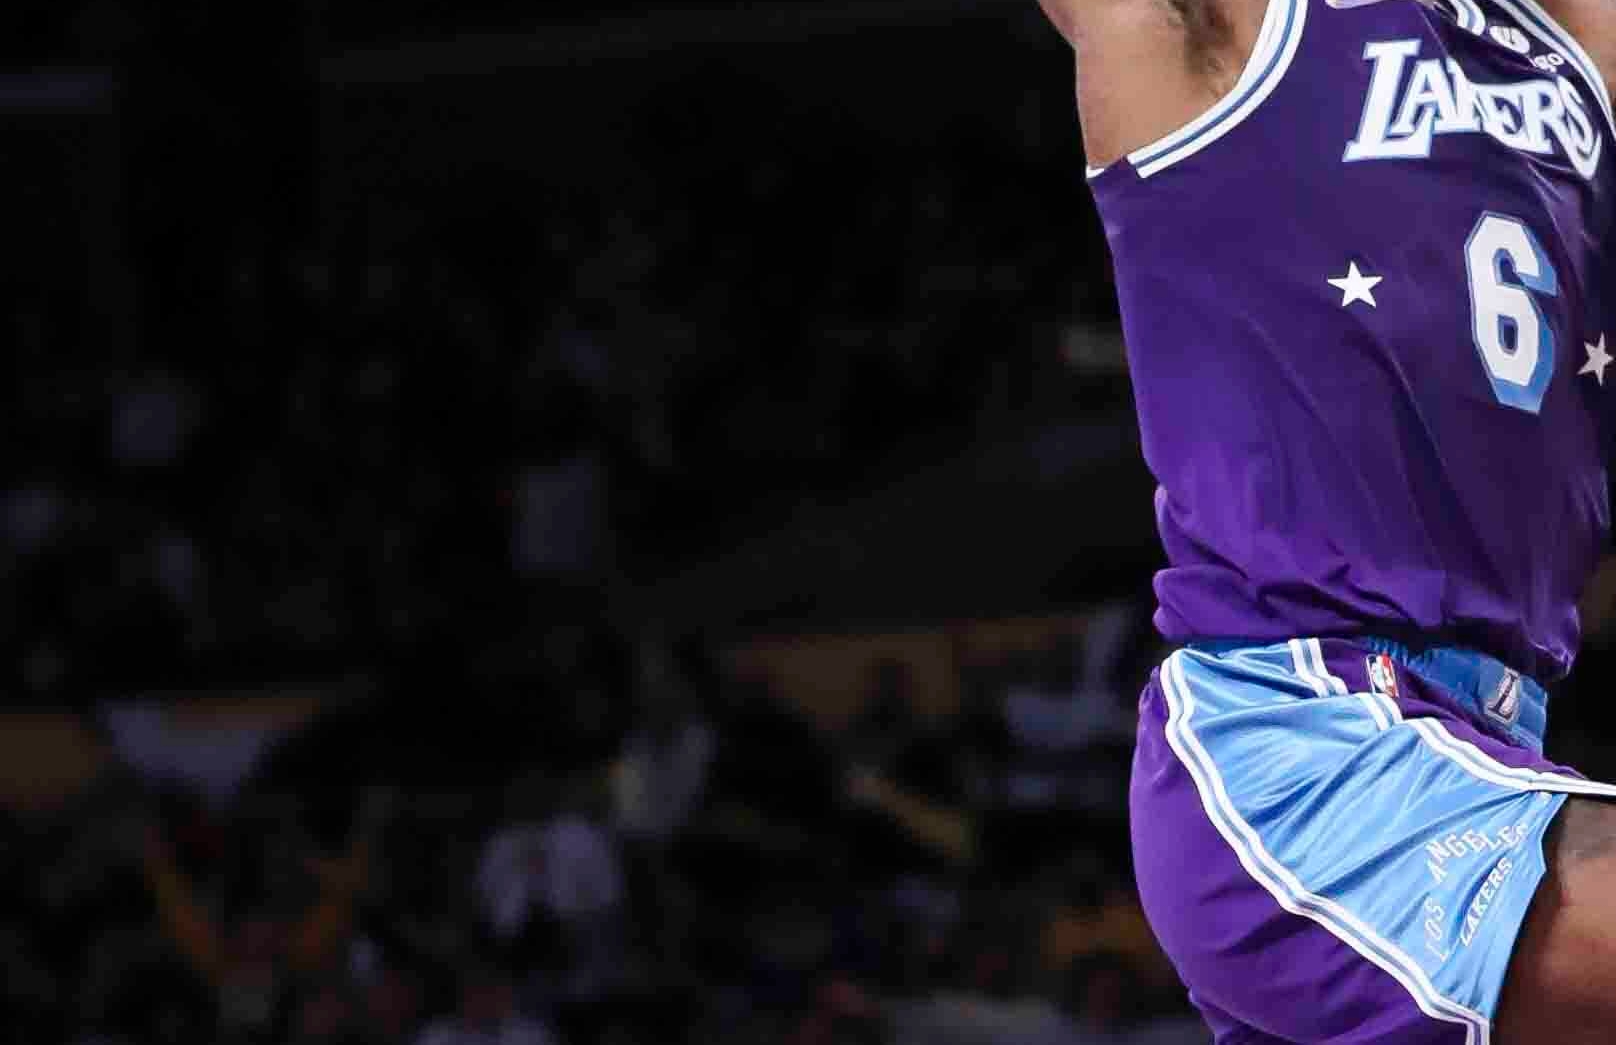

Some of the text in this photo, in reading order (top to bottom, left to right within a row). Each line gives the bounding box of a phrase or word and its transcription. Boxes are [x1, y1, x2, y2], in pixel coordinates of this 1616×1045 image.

[1342, 38, 1601, 181] LAKERS
[1464, 210, 1560, 414] 6
[1460, 856, 1514, 947] LAKERS
